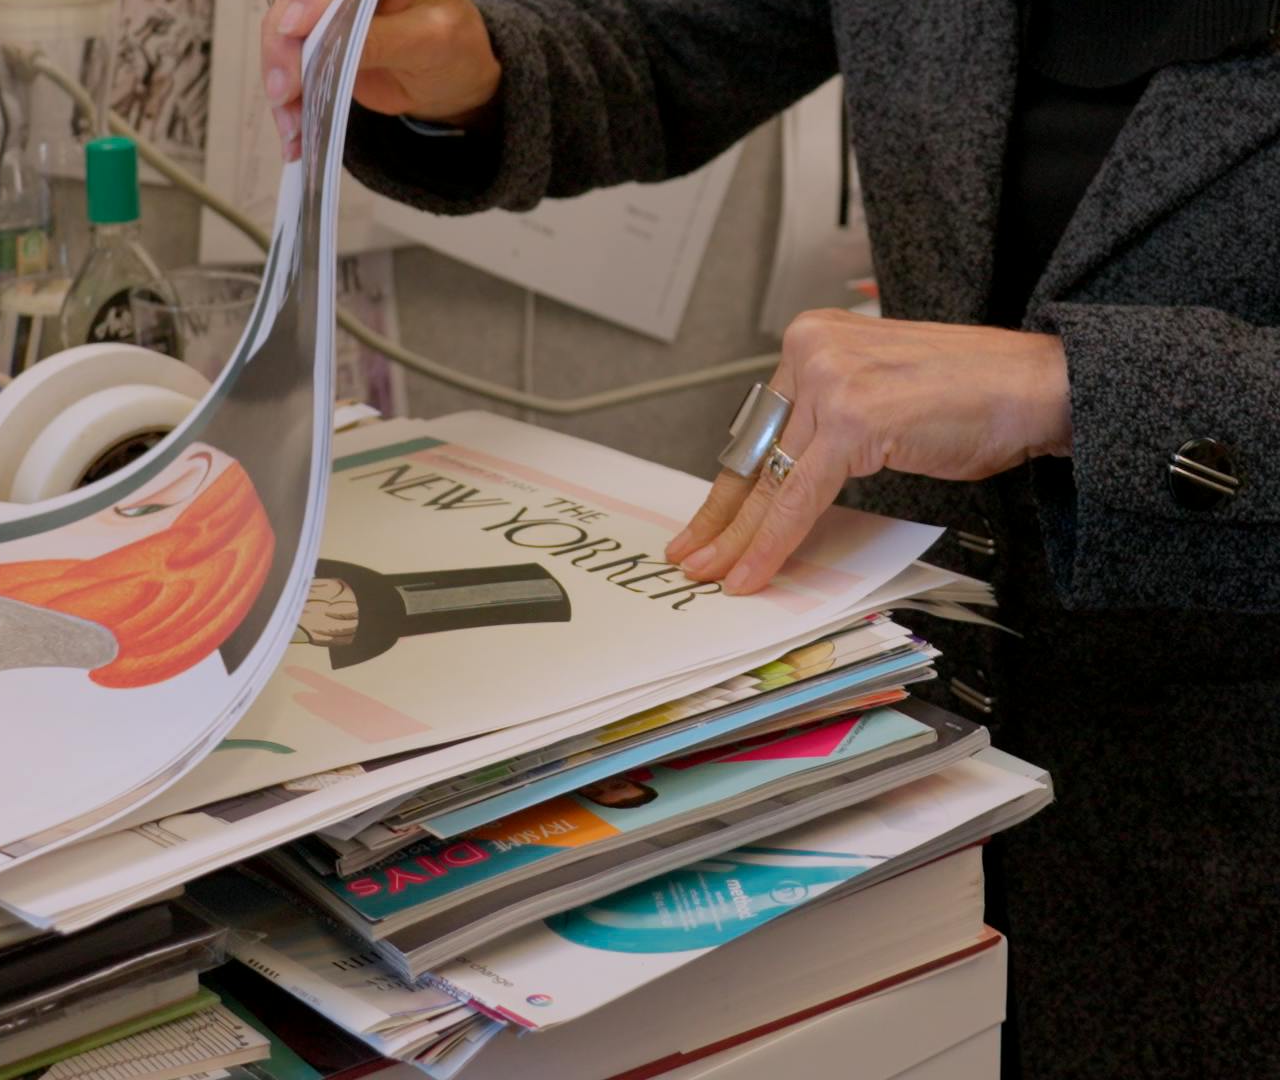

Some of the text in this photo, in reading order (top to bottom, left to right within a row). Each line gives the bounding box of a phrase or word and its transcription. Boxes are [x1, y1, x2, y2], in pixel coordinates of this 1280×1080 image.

[543, 496, 609, 524] THE
[349, 463, 511, 512] NEW
[480, 505, 723, 612] YORKER
[486, 817, 578, 856] TRY SOME
